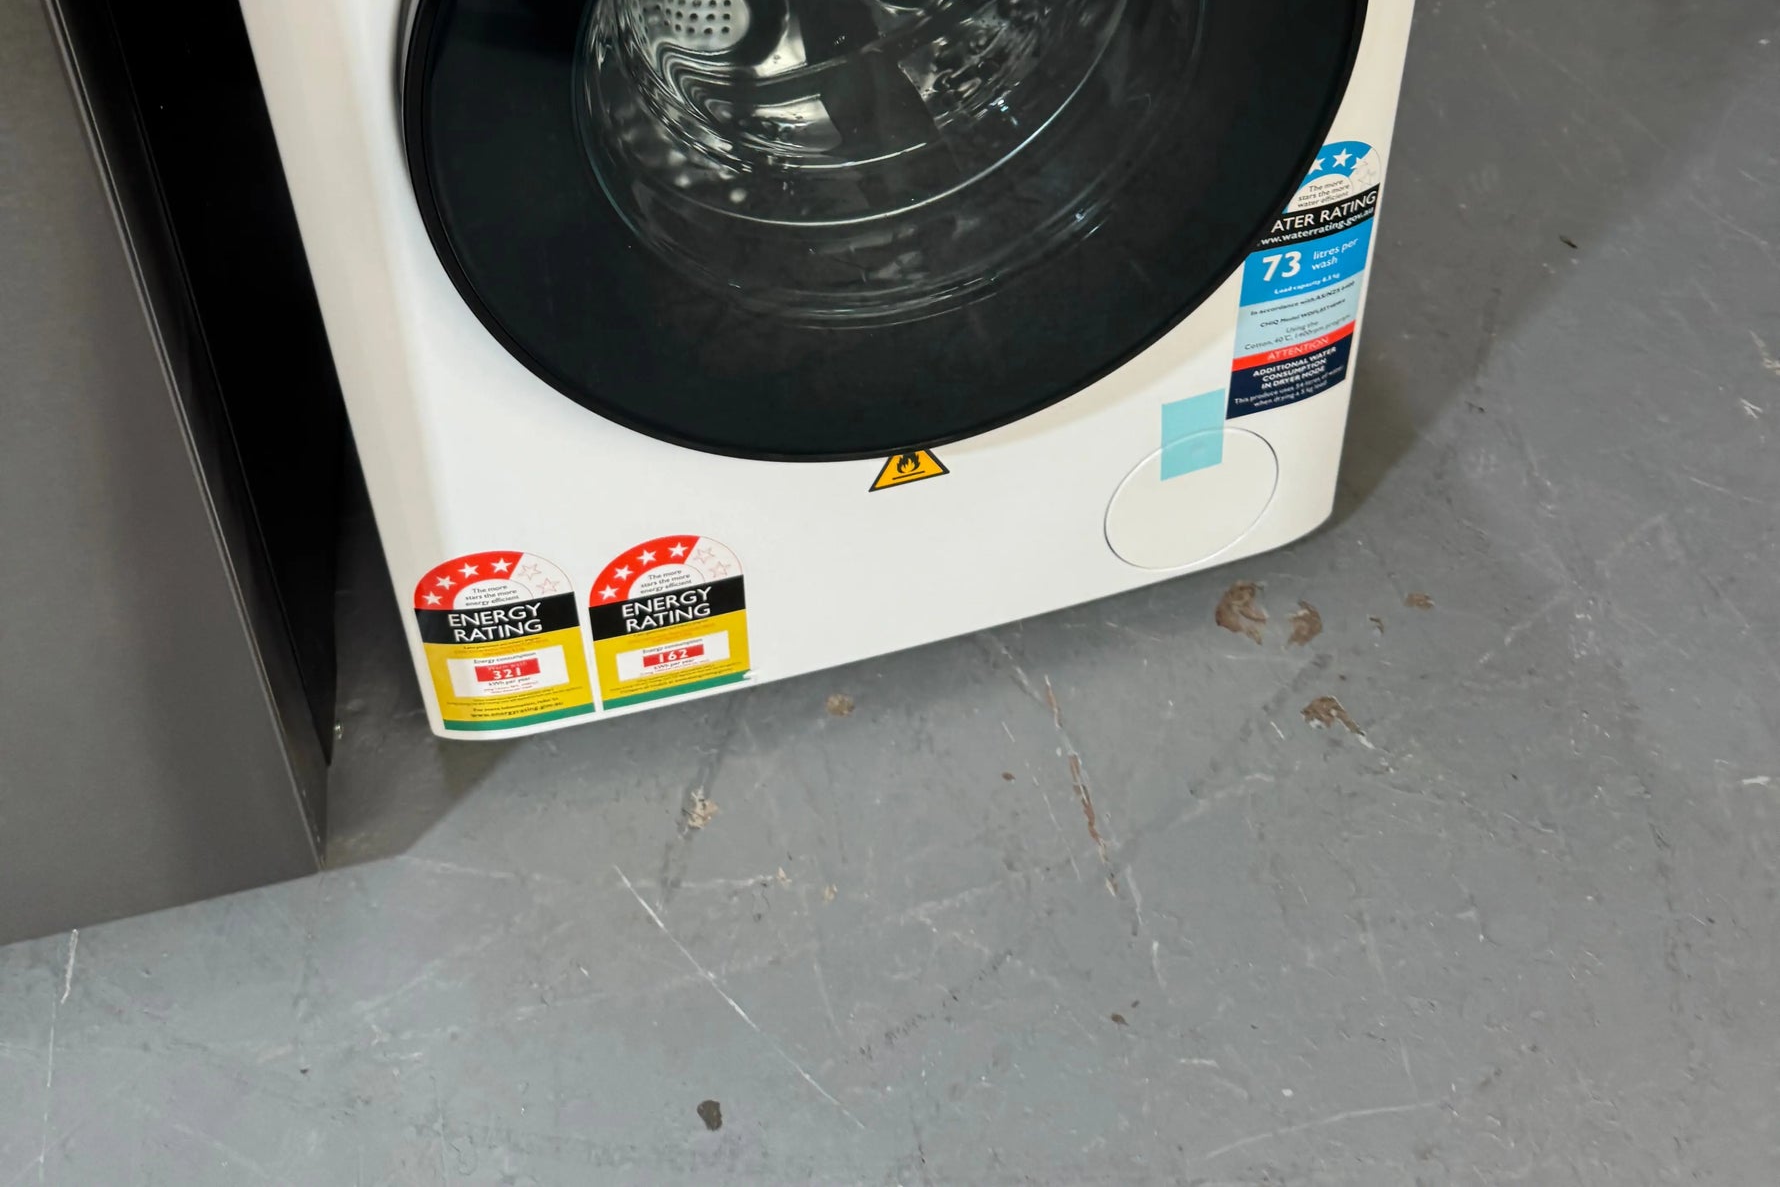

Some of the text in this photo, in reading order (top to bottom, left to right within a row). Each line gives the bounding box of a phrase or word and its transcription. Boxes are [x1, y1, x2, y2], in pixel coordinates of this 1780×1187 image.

[1298, 184, 1350, 202] stars the more
[1309, 180, 1344, 193] The more
[1270, 190, 1377, 234] ATER RATING
[1298, 191, 1349, 208] water efficient
[1258, 207, 1374, 247] ww.waterrating.gov.au
[1262, 237, 1359, 282] 73 litres per
[1311, 256, 1338, 271] wash
[1267, 336, 1330, 361] ATTENTION
[1252, 346, 1337, 377] ADDITIONAL WATER
[1262, 357, 1327, 382] CONSUMPTION
[1261, 365, 1326, 390] IN DRYER MODE
[663, 569, 682, 577] more
[671, 574, 690, 582] more
[640, 579, 692, 594] energy efficient
[465, 594, 520, 607] energy efficient
[621, 586, 712, 618] ENERGY
[449, 602, 541, 627] ENERGY
[626, 603, 711, 633] RATING
[453, 618, 543, 643] RATING
[493, 667, 522, 680] 321
